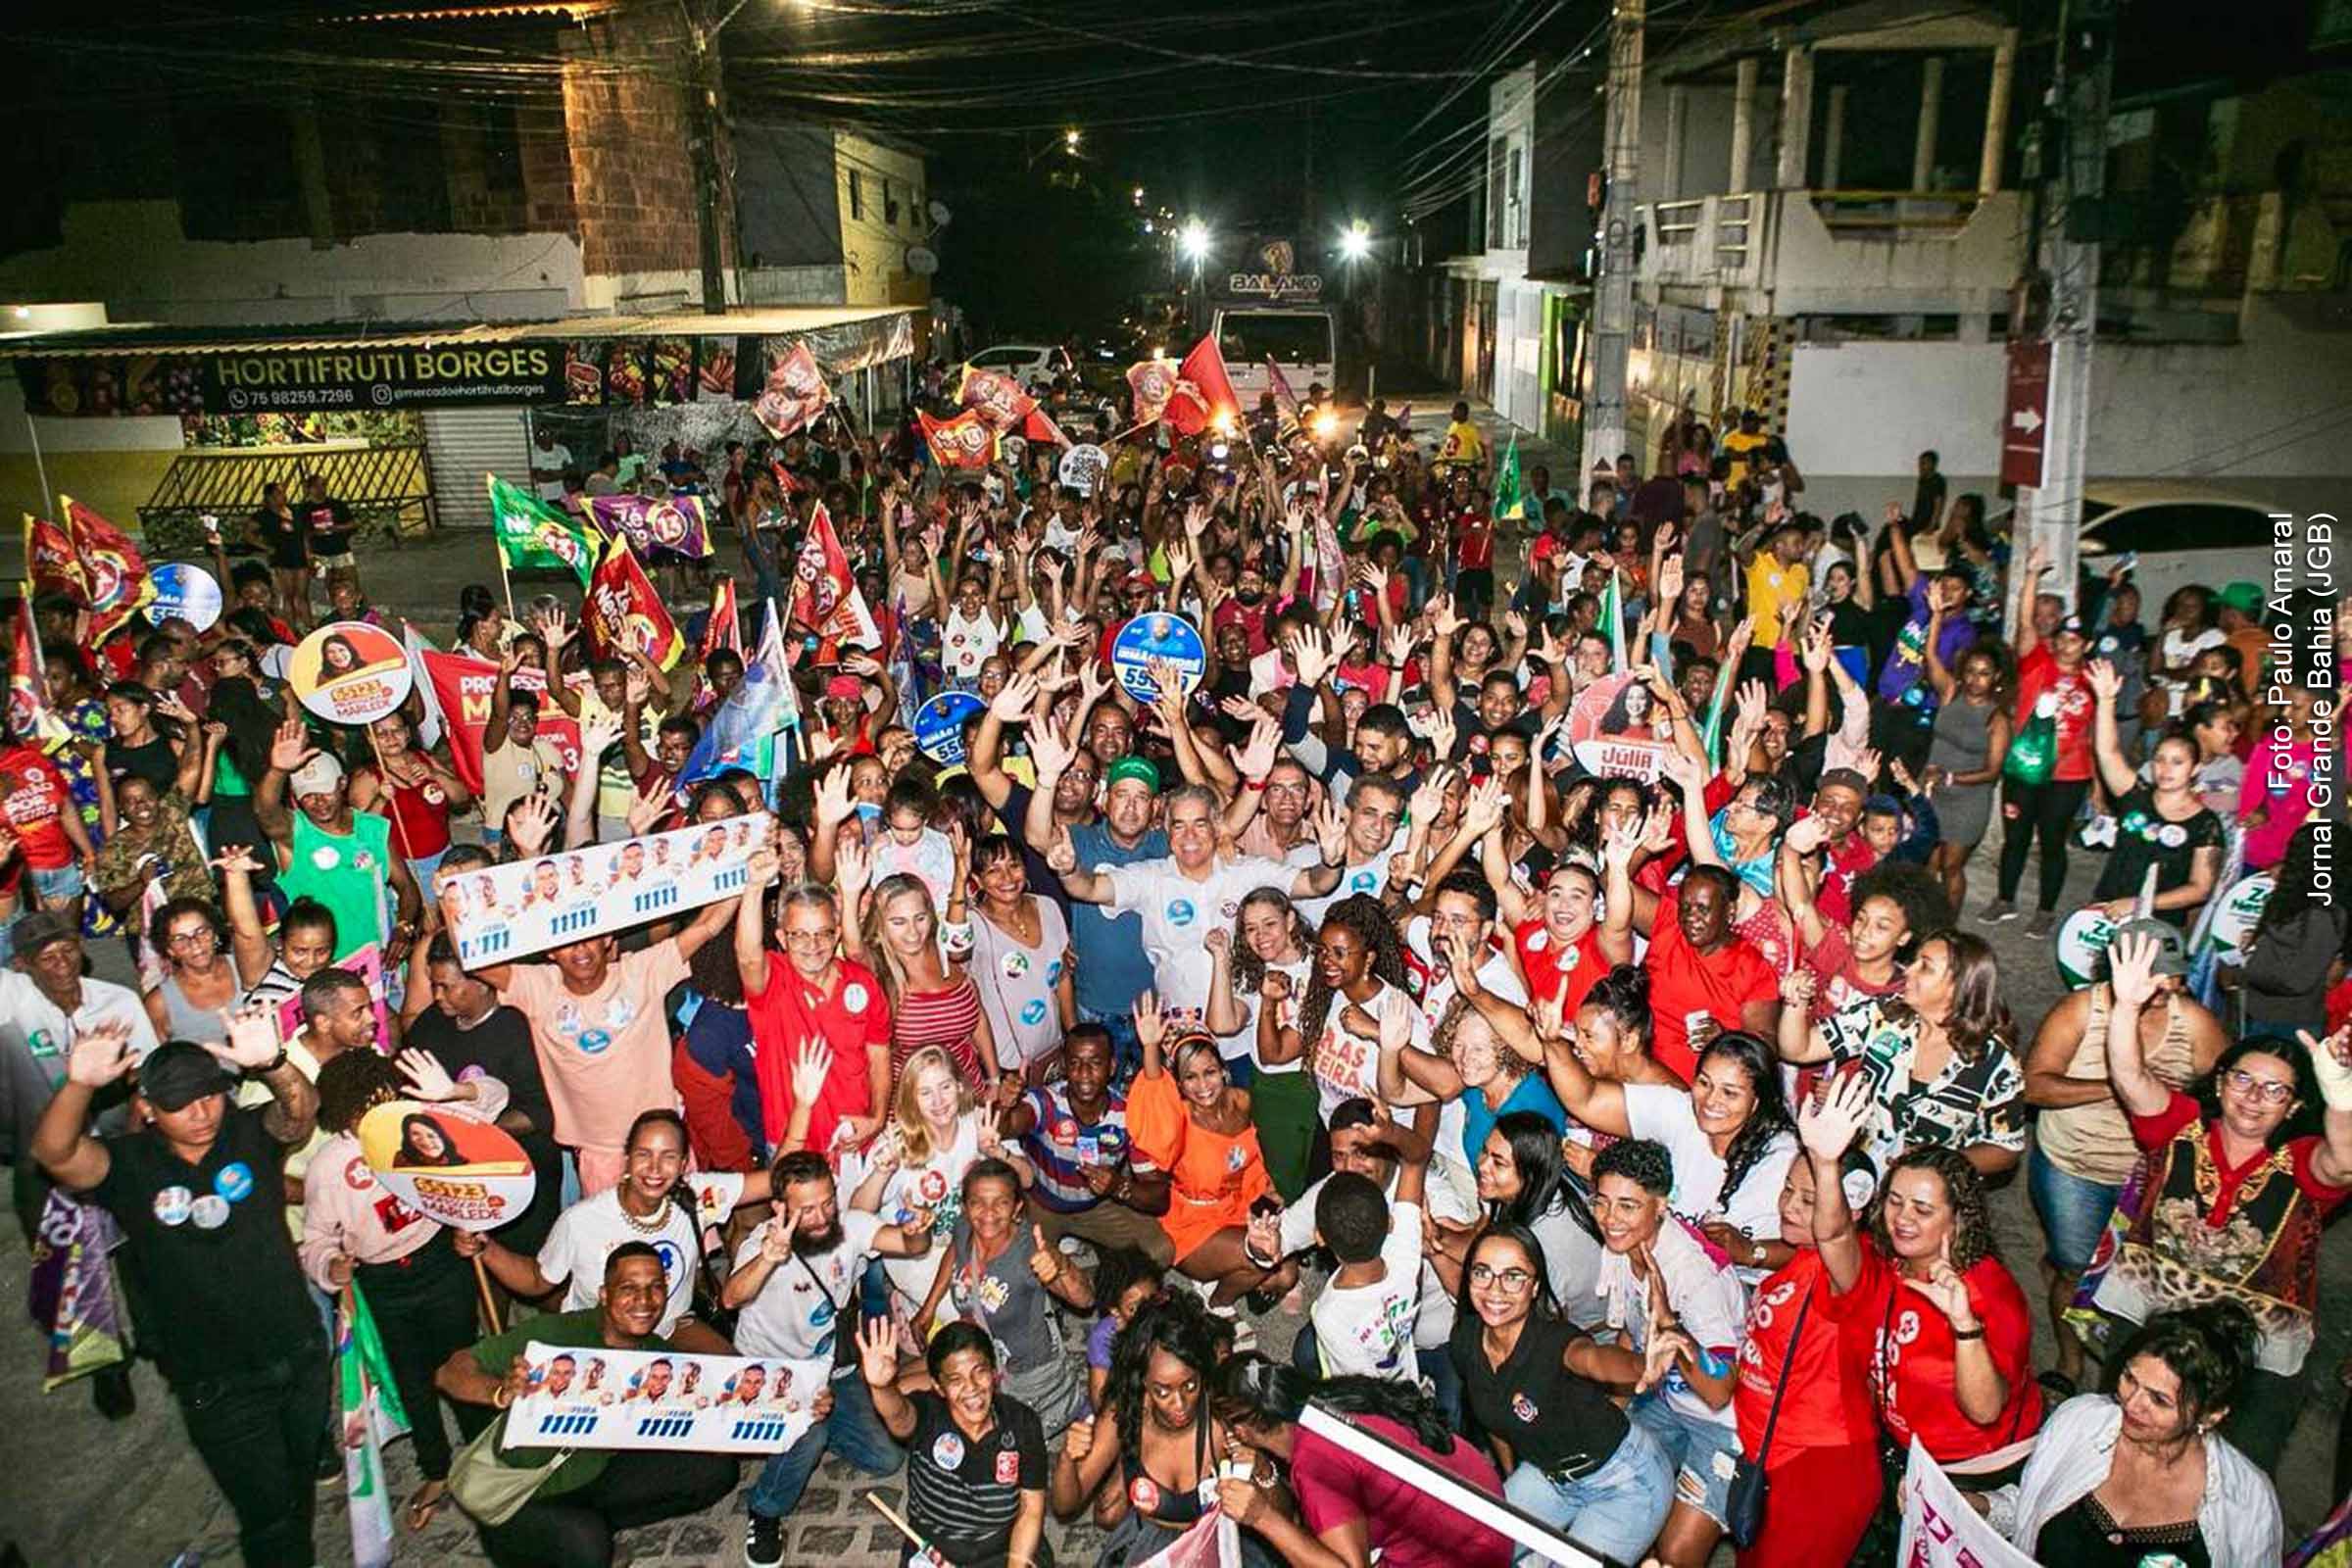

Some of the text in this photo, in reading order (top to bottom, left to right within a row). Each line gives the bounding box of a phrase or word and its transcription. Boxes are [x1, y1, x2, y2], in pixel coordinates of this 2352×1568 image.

[218, 349, 549, 385] HORTIFRUTI BORGES
[251, 391, 269, 405] 75
[634, 886, 677, 912] 11111
[551, 907, 597, 935] 11111
[539, 1414, 599, 1435] 11111
[637, 1418, 695, 1438] 11111
[731, 1421, 786, 1442] 11111
